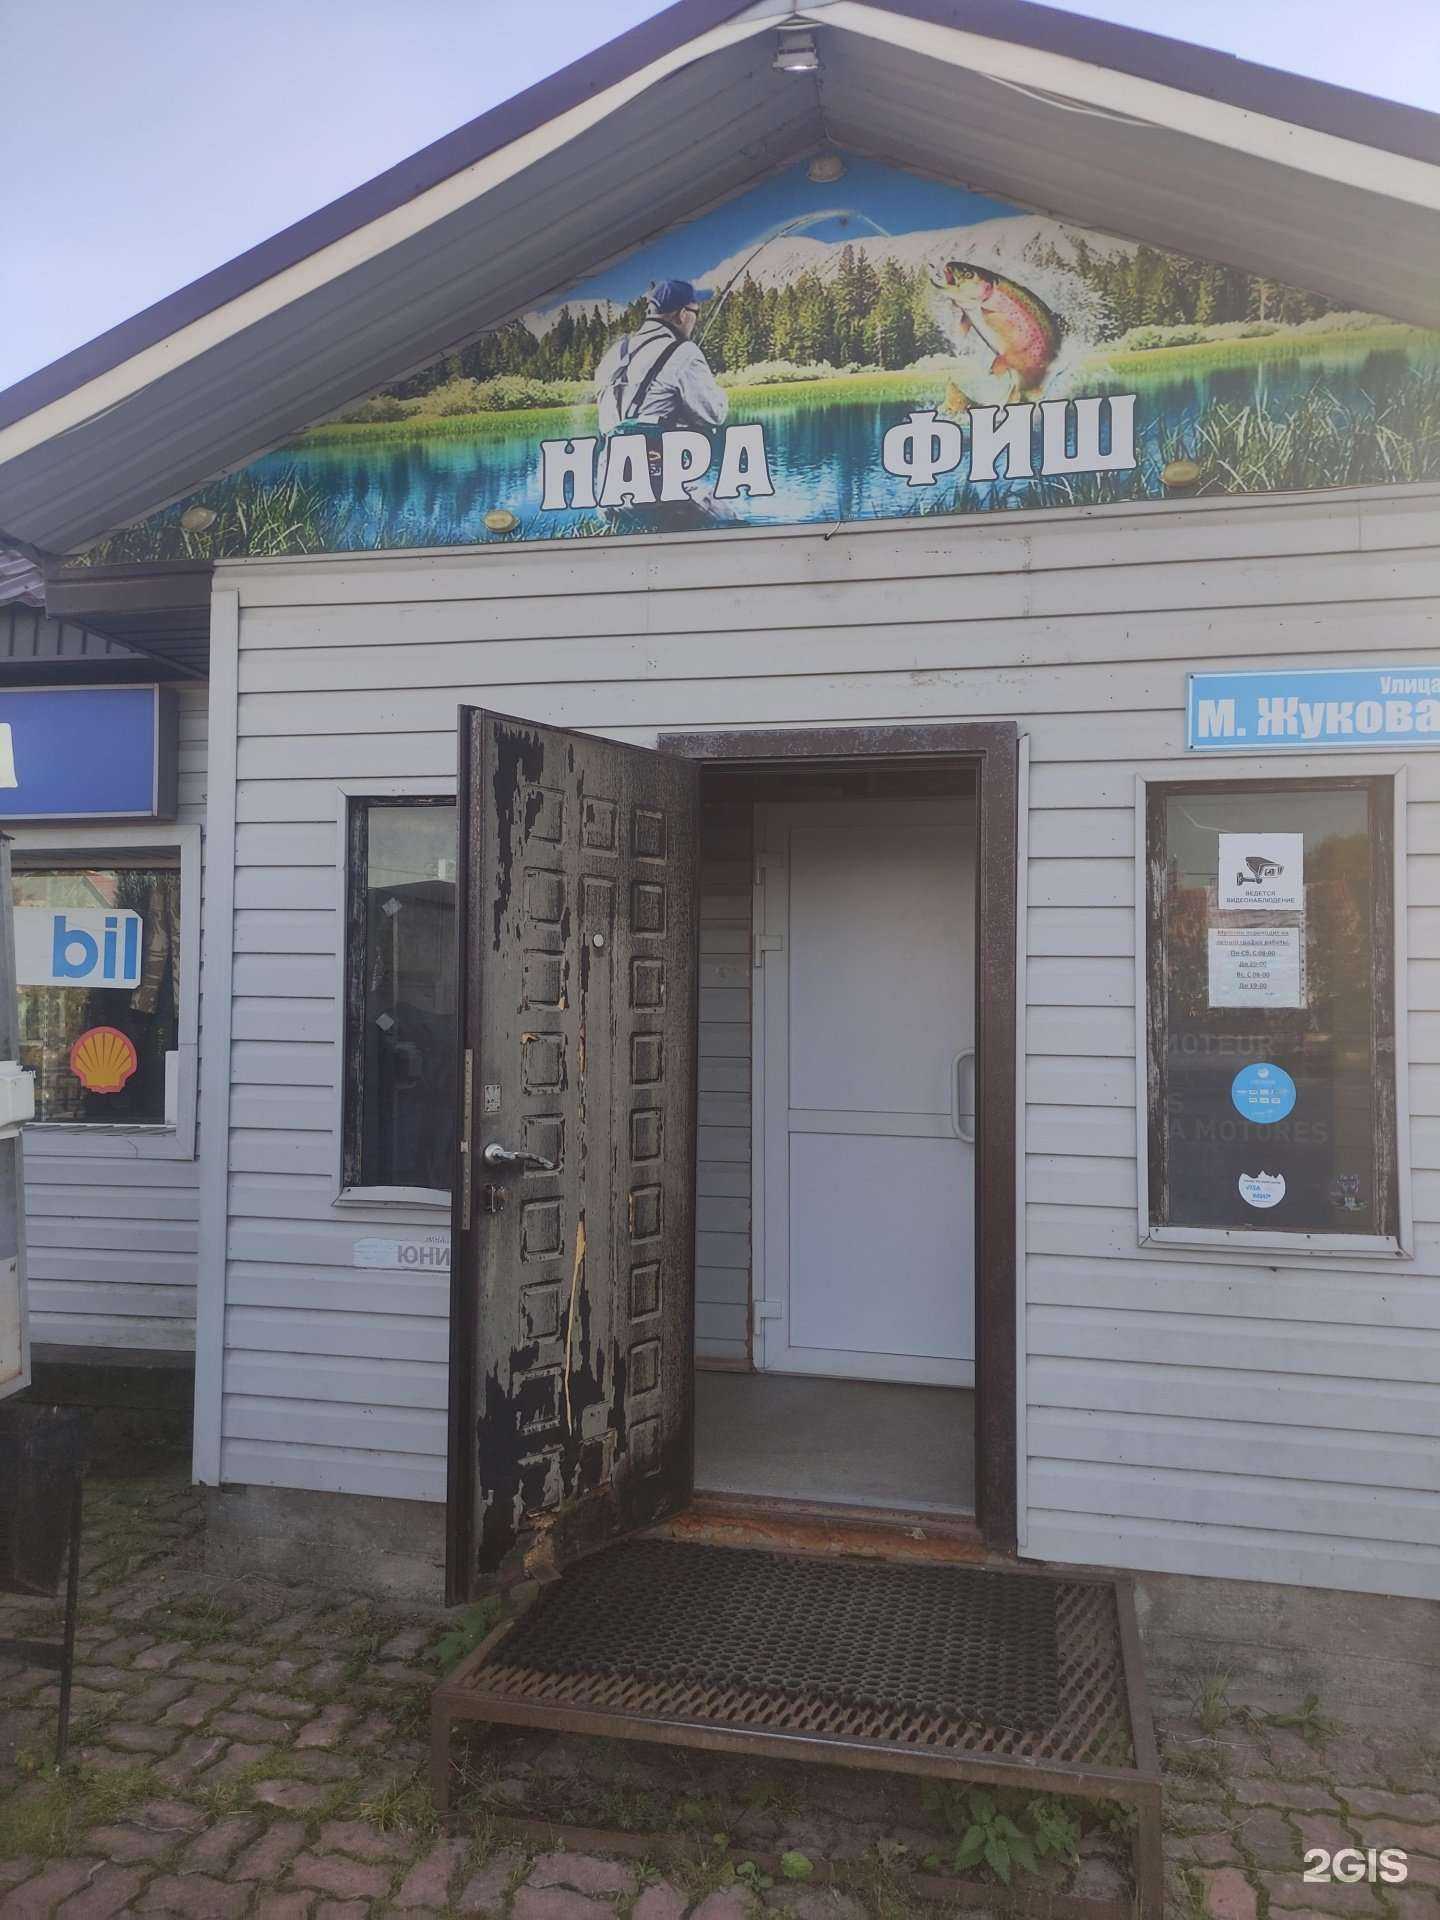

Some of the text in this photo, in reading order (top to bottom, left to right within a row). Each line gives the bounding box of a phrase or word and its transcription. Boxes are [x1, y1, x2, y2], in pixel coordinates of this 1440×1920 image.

[540, 393, 1137, 512] НАРА ФИШ
[1197, 696, 1440, 739] М. Жукова
[52, 915, 139, 980] bil
[397, 1245, 450, 1266] ЮНИ
